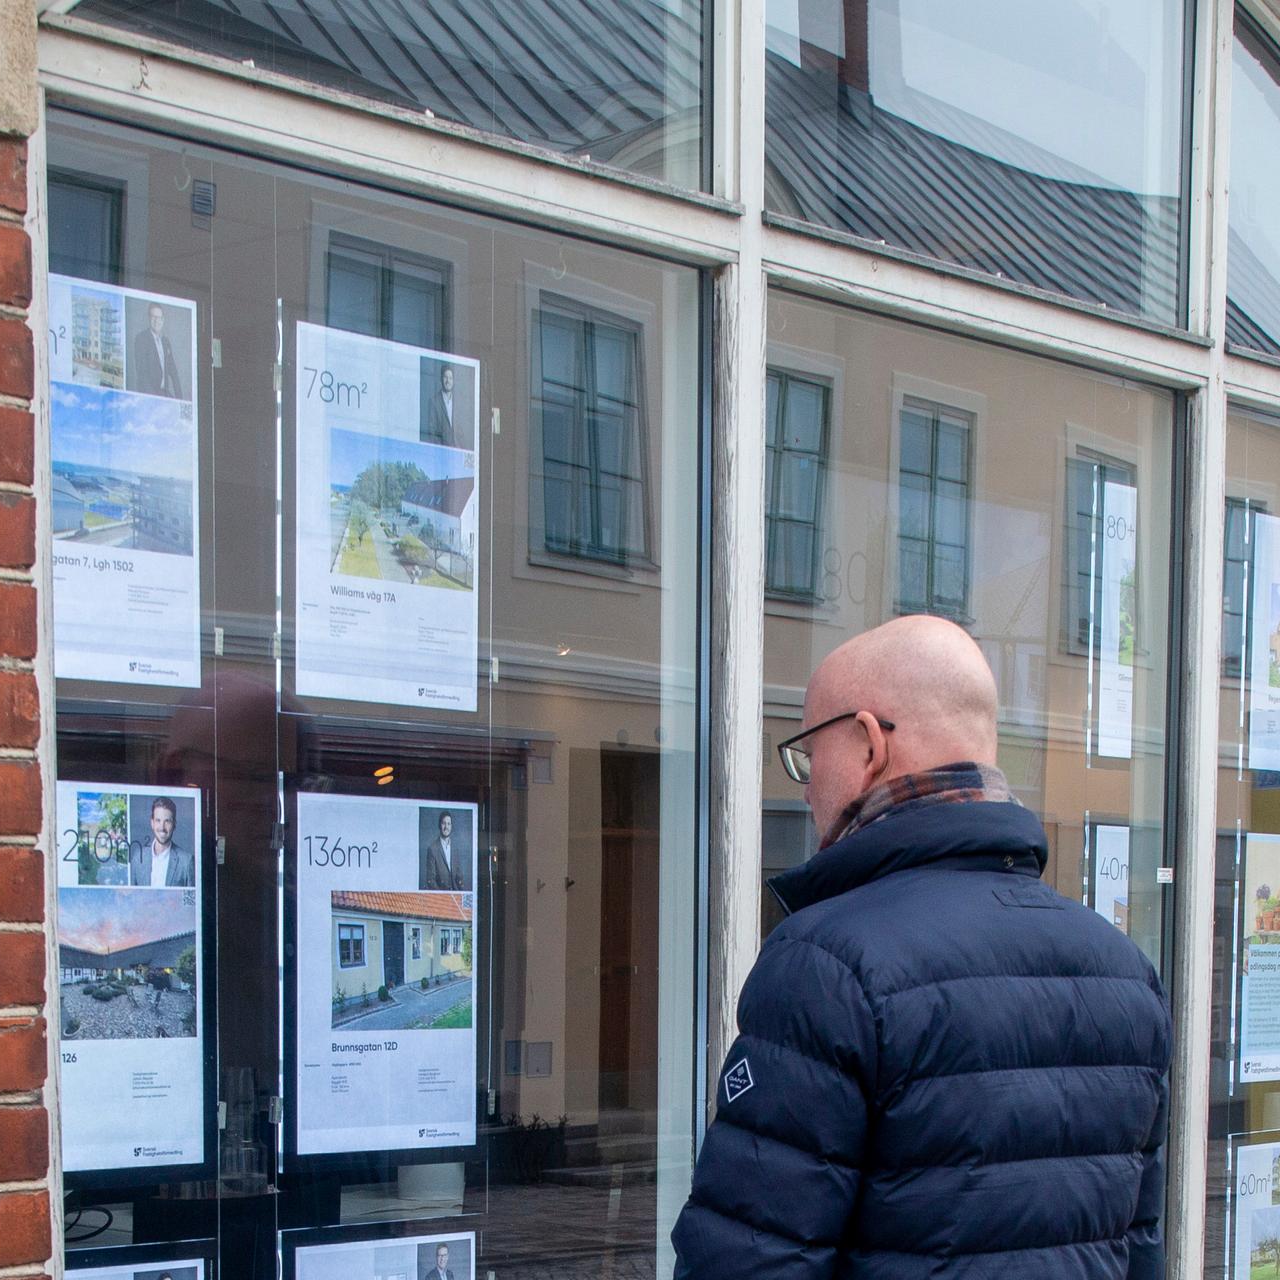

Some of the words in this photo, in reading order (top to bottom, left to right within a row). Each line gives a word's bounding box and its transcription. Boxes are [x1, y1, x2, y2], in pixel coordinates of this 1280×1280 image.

[303, 366, 368, 409] 78m²
[93, 558, 111, 572] Lgh
[112, 560, 135, 572] 1502
[330, 584, 365, 599] Williams
[367, 590, 382, 603] väg
[383, 592, 397, 604] 17A
[303, 835, 379, 869] 136m²
[331, 1042, 382, 1055] Brunnsgatan
[383, 1041, 398, 1052] 12D
[62, 1053, 78, 1064] 126
